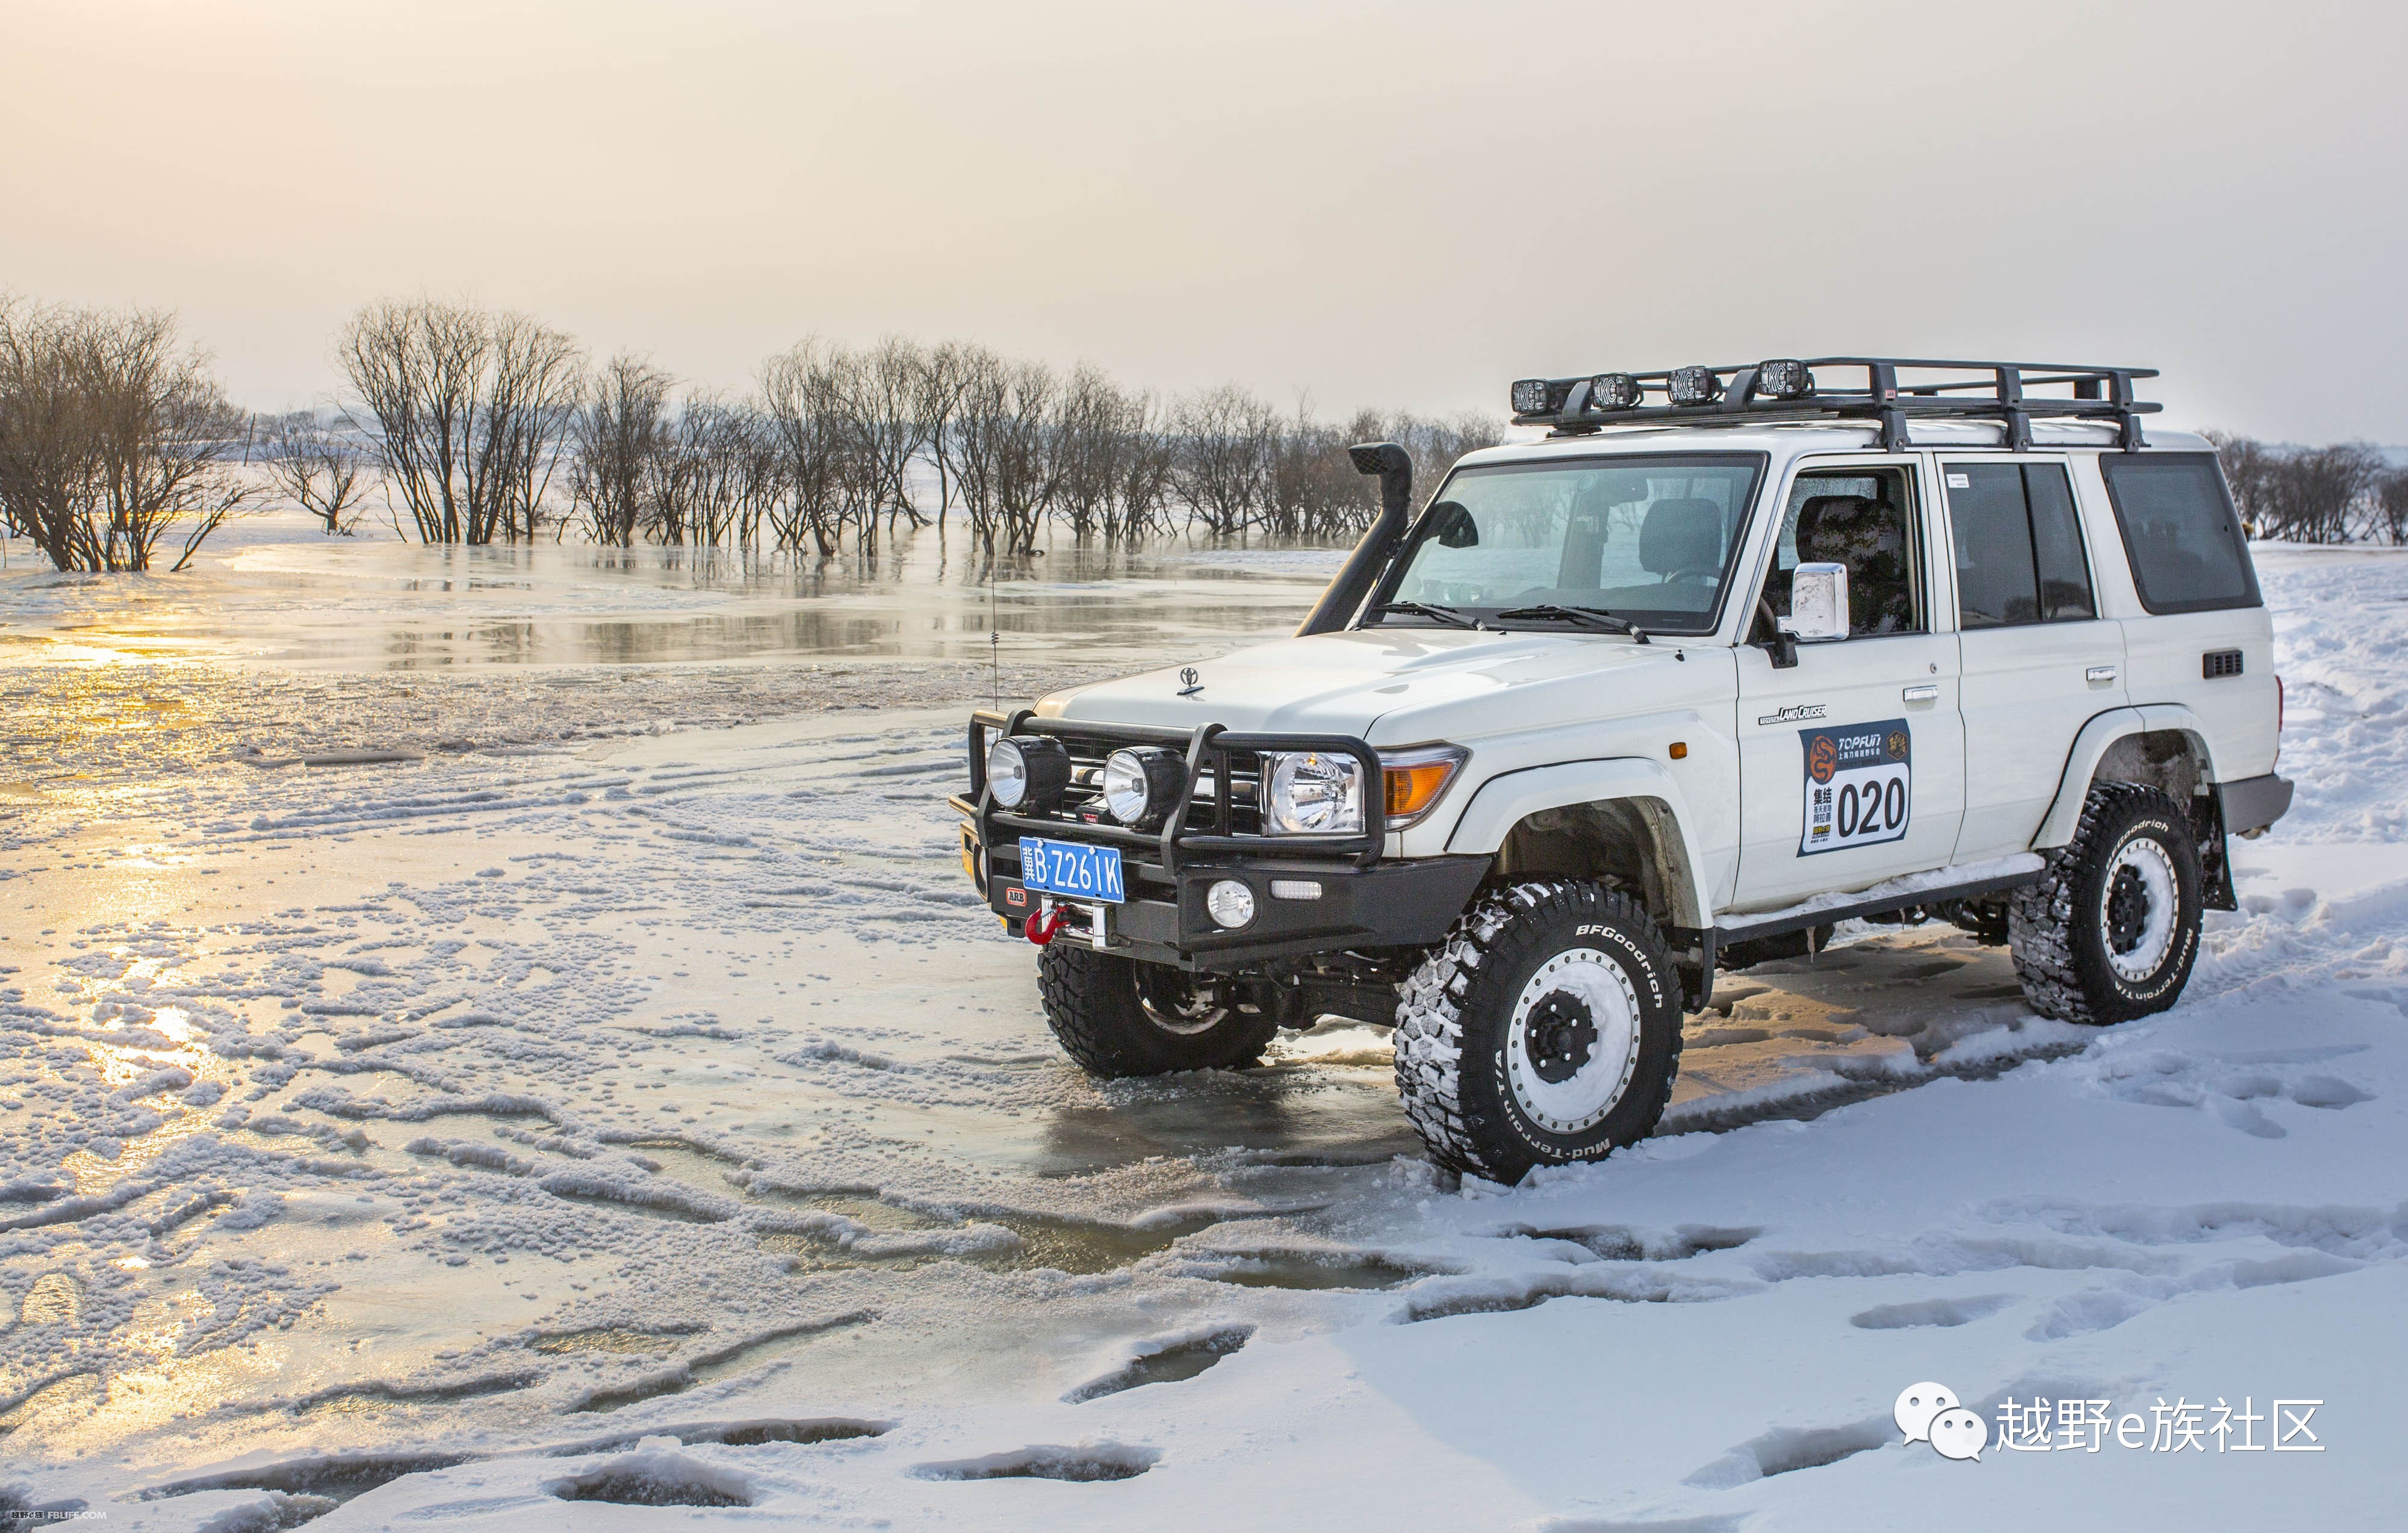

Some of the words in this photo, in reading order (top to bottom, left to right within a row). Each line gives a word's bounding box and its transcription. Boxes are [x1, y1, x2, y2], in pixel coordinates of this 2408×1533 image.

[1598, 378, 1616, 404] KC
[1675, 371, 1695, 398] KC
[1766, 363, 1786, 392] KC
[1518, 383, 1534, 409] KC
[1814, 787, 1832, 805] 集结
[1838, 777, 1905, 838] 020
[1813, 813, 1832, 825] 阿拉善
[1009, 891, 1024, 902] ARB
[1575, 924, 1662, 1008] BFGoodrich
[2136, 928, 2193, 1001] Mud-Terrain
[1495, 1049, 1504, 1095] T/A
[1503, 1100, 1611, 1159] Mud-Terrain
